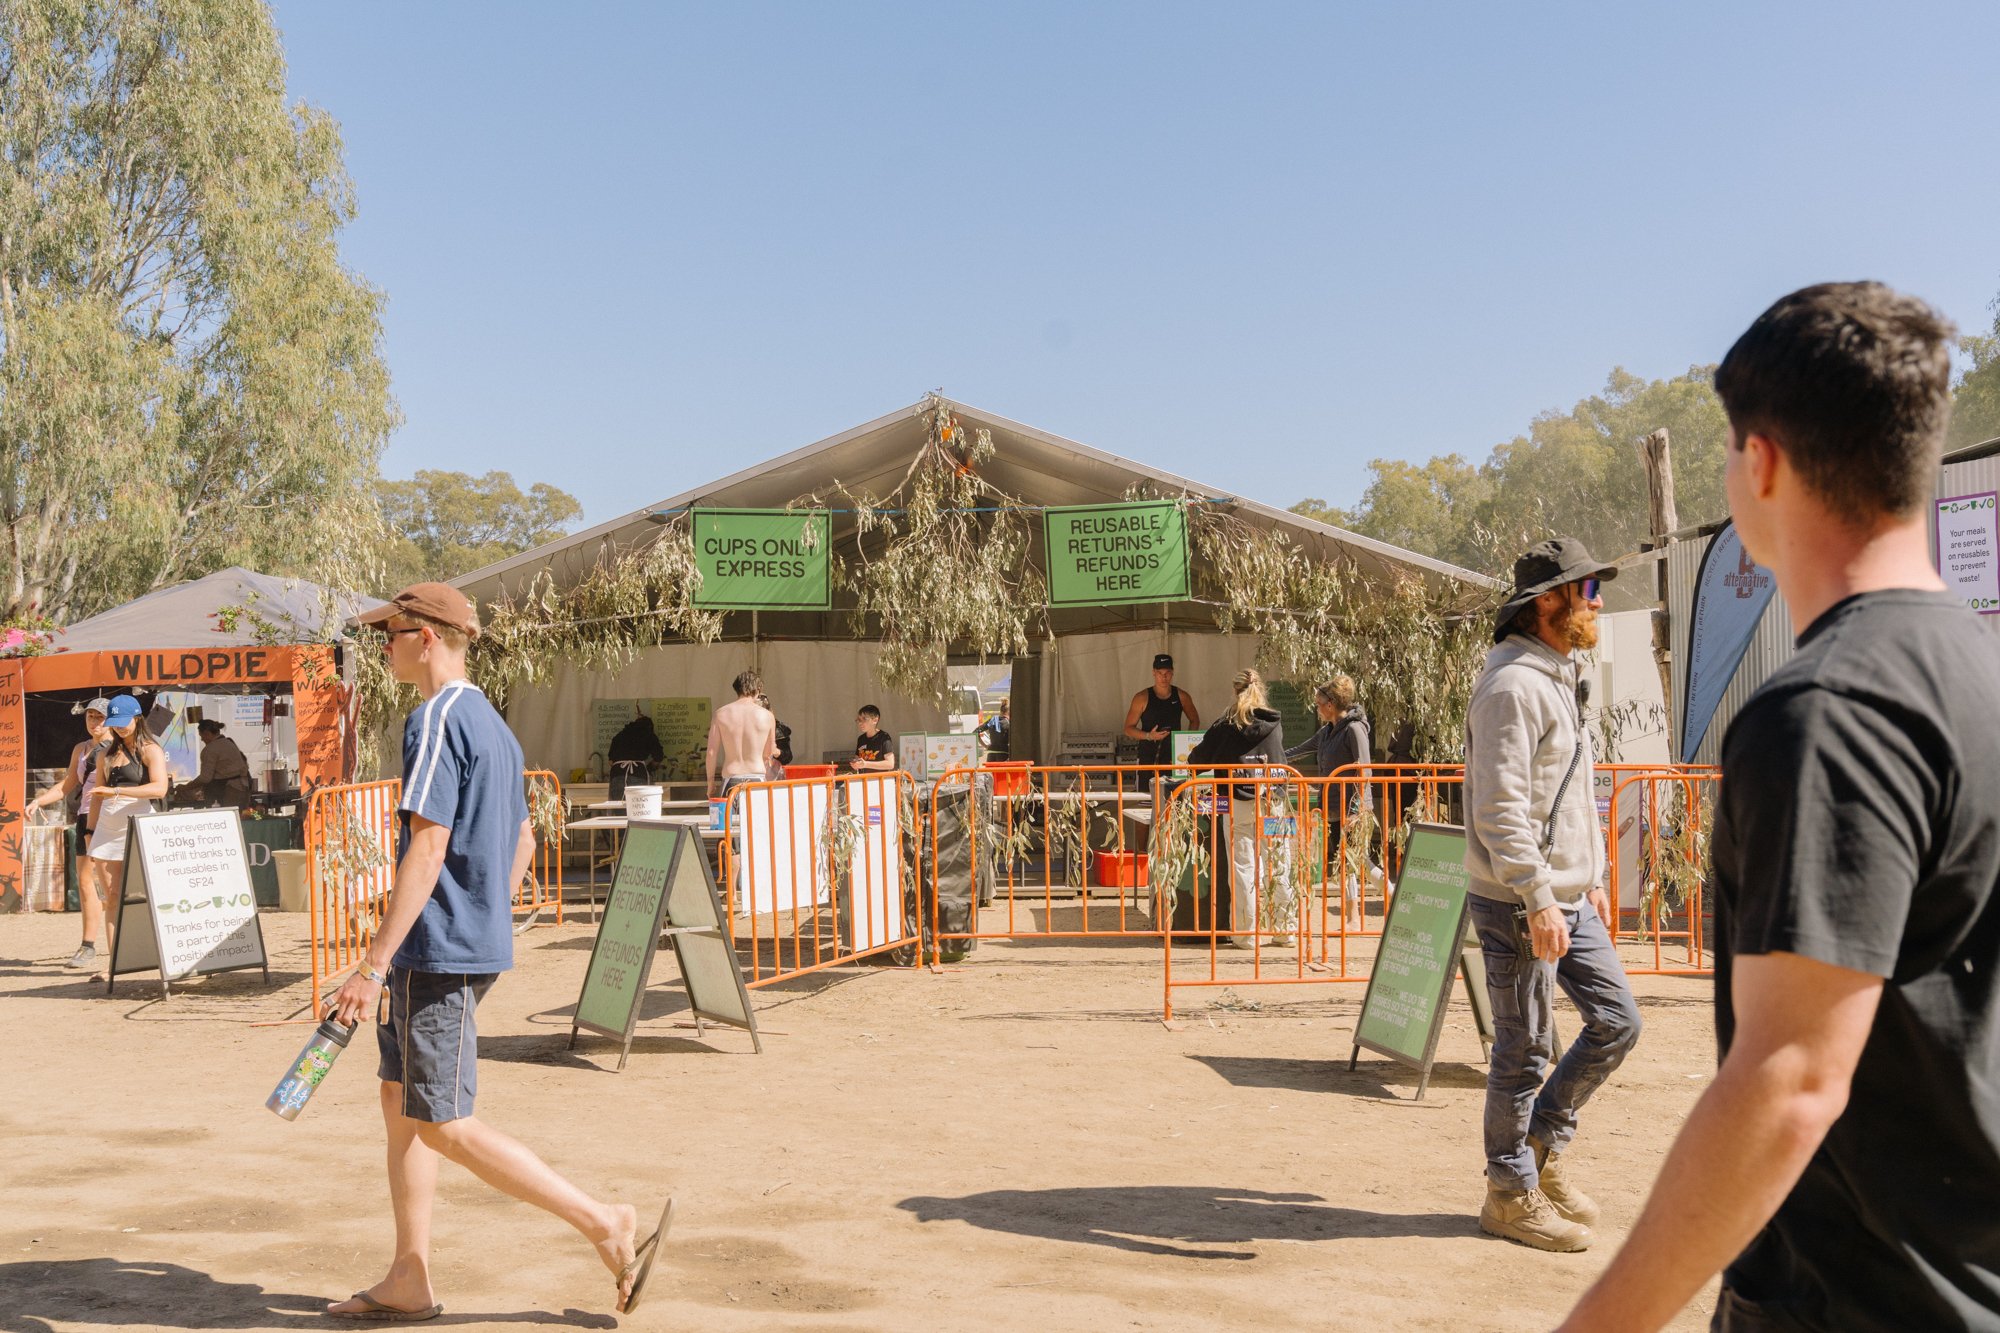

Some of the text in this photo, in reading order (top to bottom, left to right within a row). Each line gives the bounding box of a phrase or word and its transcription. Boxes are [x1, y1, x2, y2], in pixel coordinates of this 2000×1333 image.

[1071, 514, 1160, 534] REUSABLE
[1950, 526, 1986, 538] Your meals
[704, 538, 757, 555] CUPS
[1068, 534, 1152, 554] RETURNS
[1950, 538, 1986, 549] are served
[1076, 553, 1159, 573] REFUNDS
[1957, 550, 1990, 559] reusables
[716, 560, 805, 578] EXPRESS
[1704, 559, 1717, 587] RECYCLE
[1952, 561, 1986, 572] to prevent
[1096, 574, 1141, 591] HERE
[1724, 572, 1768, 588] alternative
[1959, 574, 1980, 583] waste!
[1698, 595, 1706, 626] RETURN
[1695, 633, 1703, 663] RECYCLE
[112, 652, 268, 680] WILDPIE
[1691, 672, 1699, 702] RETURN
[0, 694, 20, 707] ILD
[152, 821, 227, 835] We prevented
[162, 835, 223, 849] 750kg from
[152, 848, 237, 864] landfill thanks to
[1410, 856, 1434, 868] DEPOSIT
[168, 862, 229, 876] reusables in
[618, 865, 665, 890] REUSABLE
[189, 877, 214, 888] SF24
[613, 890, 656, 916] RETURNS
[1401, 890, 1412, 901] EAT
[165, 915, 251, 935] Thanks for being
[1392, 925, 1412, 938] RETURN
[177, 930, 246, 949] a part of this
[172, 943, 254, 965] positive impact!
[601, 938, 642, 967] REFUNDS
[601, 967, 626, 991] HERE
